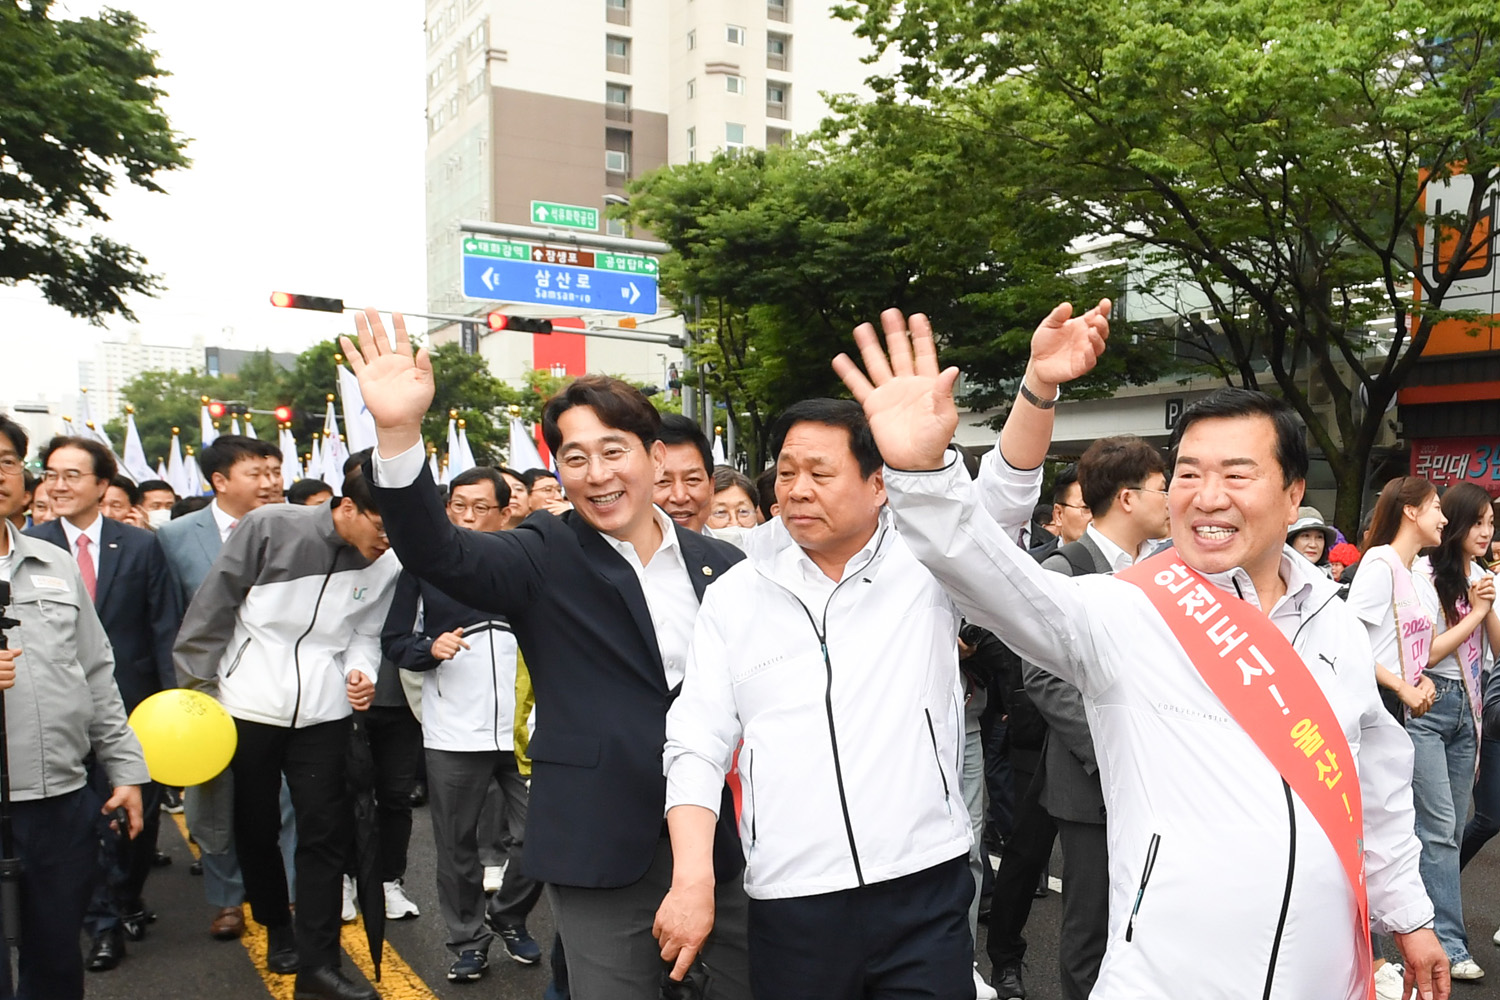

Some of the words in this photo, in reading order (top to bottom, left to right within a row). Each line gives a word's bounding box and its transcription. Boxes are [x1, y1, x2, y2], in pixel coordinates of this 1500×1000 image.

[551, 207, 594, 227] 석유화학공단
[478, 241, 524, 258] 태화강역
[545, 250, 578, 264] 장생포
[493, 273, 500, 286] E
[535, 269, 591, 289] 삼산로
[535, 287, 591, 304] Samsan-ro
[621, 287, 630, 299] W
[1169, 402, 1178, 426] P
[1416, 453, 1470, 480] 국민대
[1153, 562, 1291, 716] 안전도시!
[1289, 717, 1353, 823] 울산!
